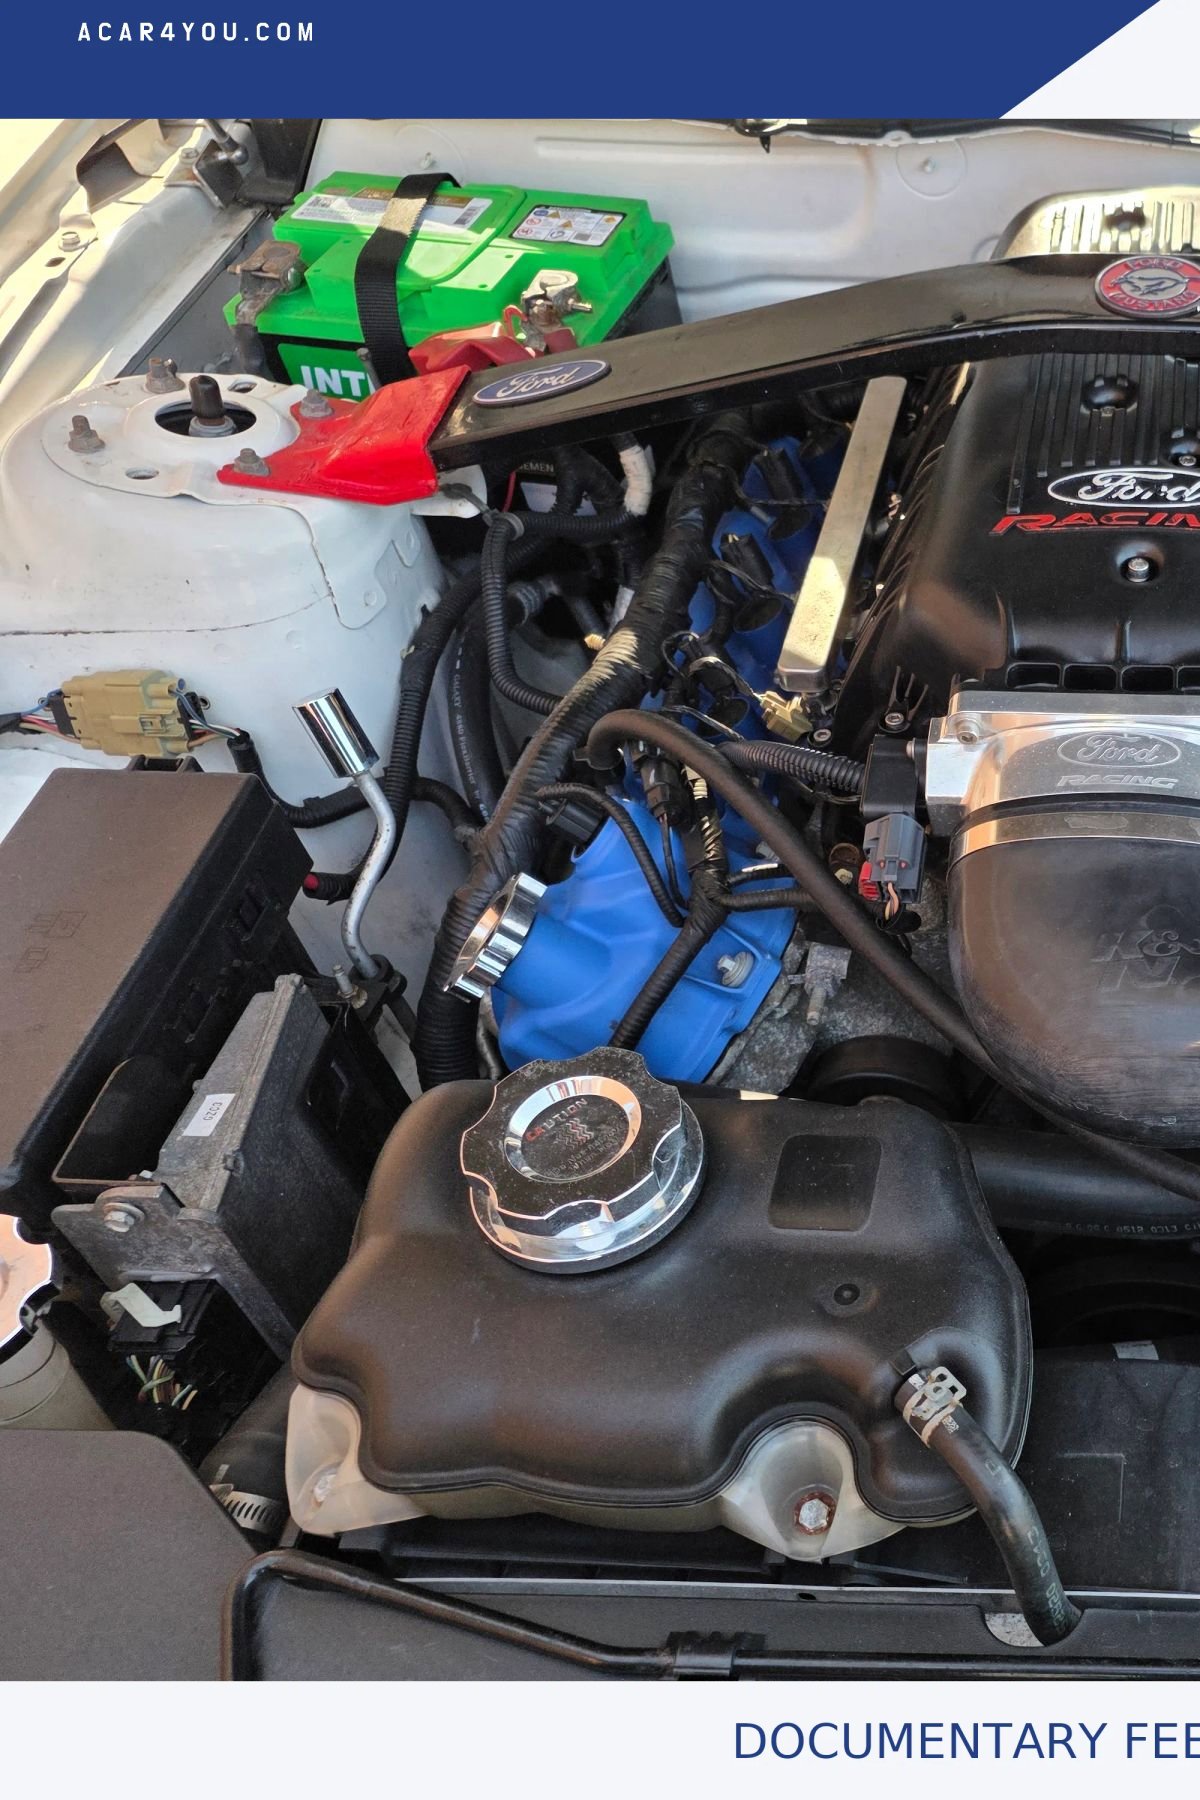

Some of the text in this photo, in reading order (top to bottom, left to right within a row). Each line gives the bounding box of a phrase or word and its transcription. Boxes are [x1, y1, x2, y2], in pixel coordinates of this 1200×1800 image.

[1106, 291, 1200, 309] MUSTANG
[300, 365, 376, 397] INT
[496, 366, 580, 398] Ford
[1077, 735, 1161, 763] Ford
[1057, 774, 1179, 790] RACING
[525, 1098, 588, 1142] CAUTION
